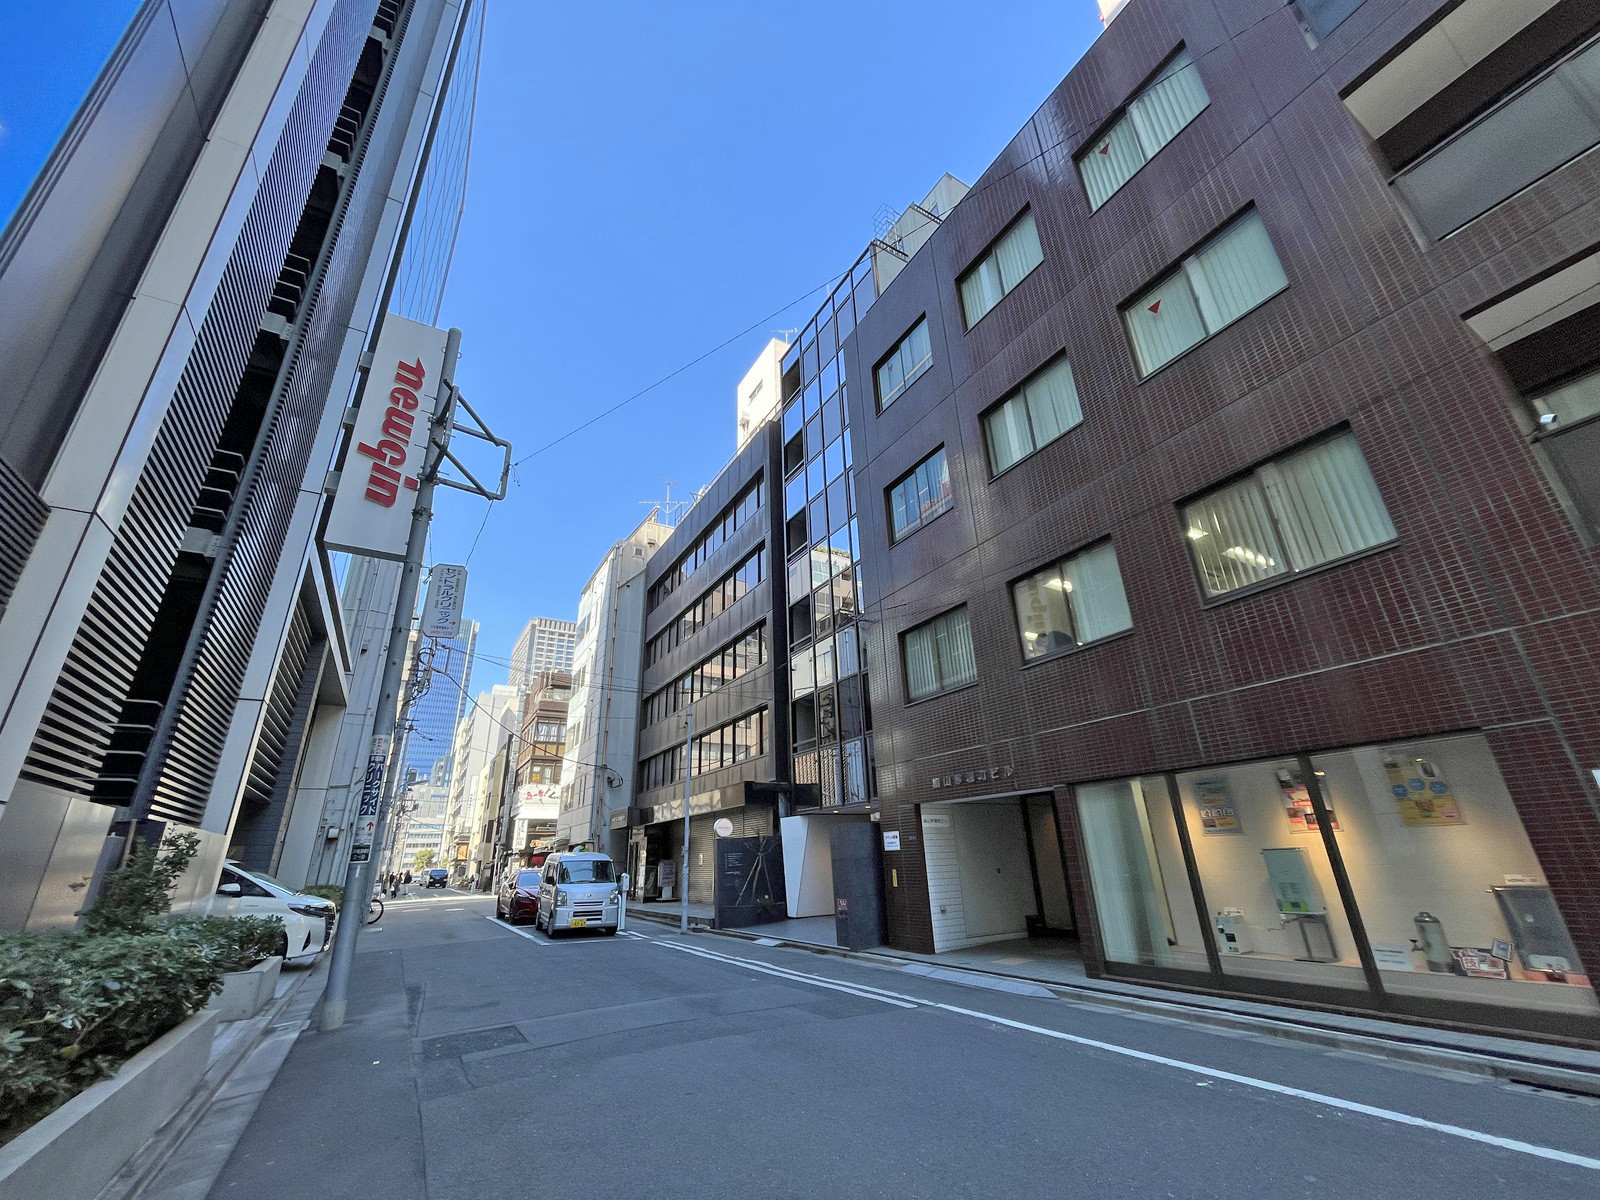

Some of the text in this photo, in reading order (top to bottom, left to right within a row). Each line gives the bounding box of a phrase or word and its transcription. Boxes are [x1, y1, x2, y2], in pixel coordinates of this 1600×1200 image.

[357, 357, 426, 508] newgin
[437, 567, 457, 624] セントラルクリニック
[360, 762, 376, 815] クリニック
[368, 763, 385, 815] パークサイド
